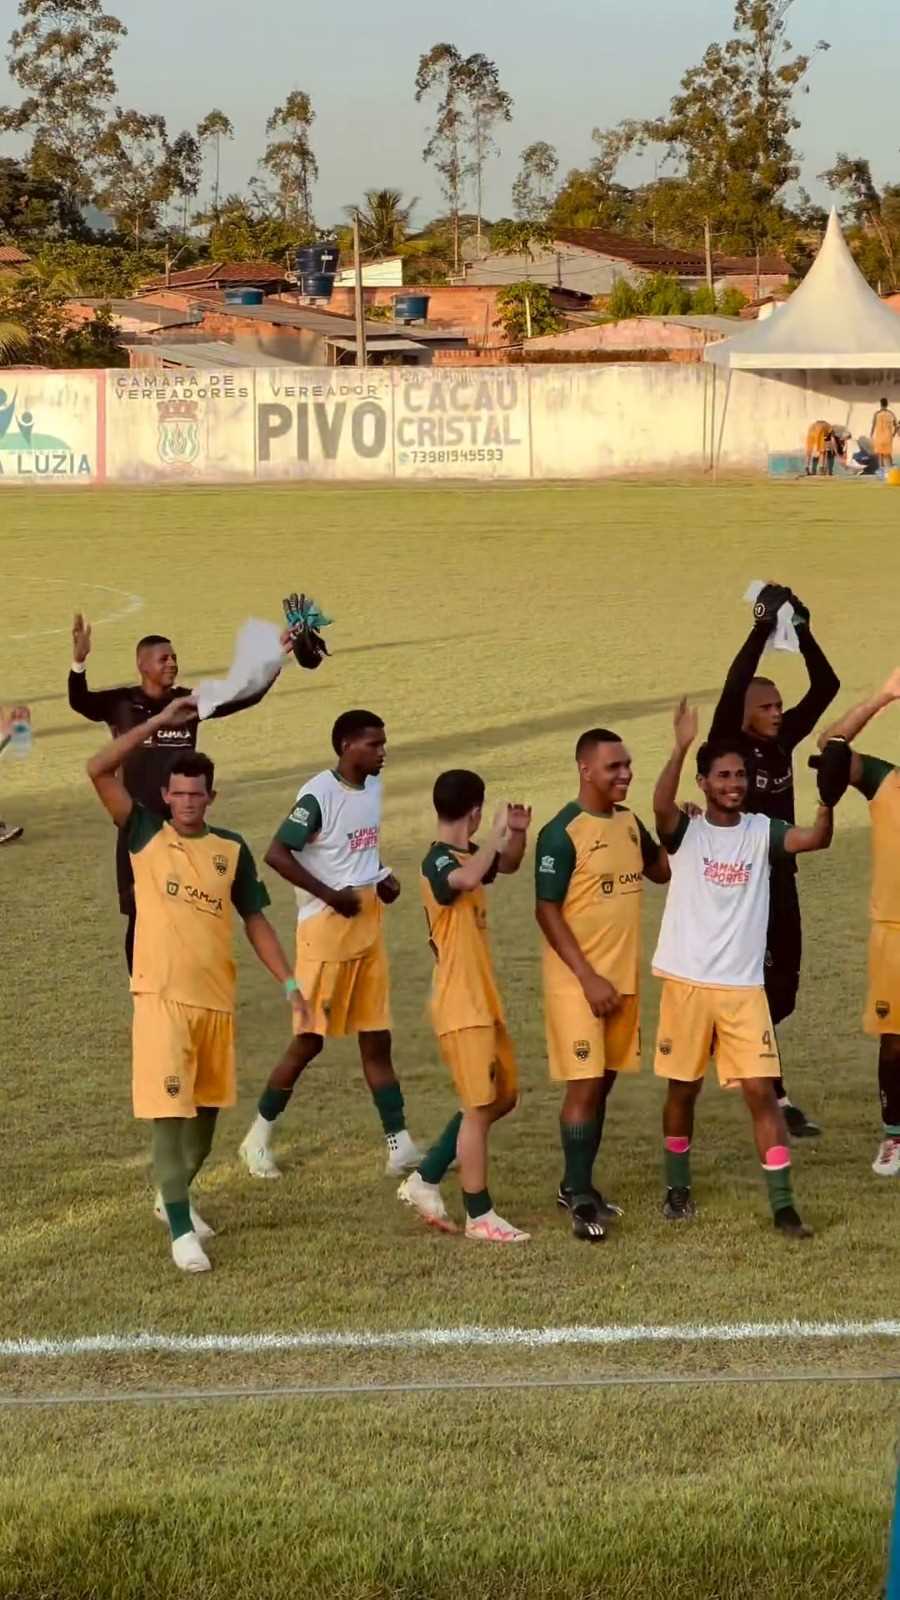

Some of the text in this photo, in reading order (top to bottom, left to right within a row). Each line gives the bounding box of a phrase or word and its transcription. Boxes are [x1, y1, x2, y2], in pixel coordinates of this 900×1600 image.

[209, 375, 235, 386] DE
[115, 387, 249, 400] VEREADORES
[271, 385, 377, 397] VEREADOR
[404, 380, 517, 412] CACAU
[397, 415, 521, 447] CRISTAL
[17, 453, 91, 475] LUZIA
